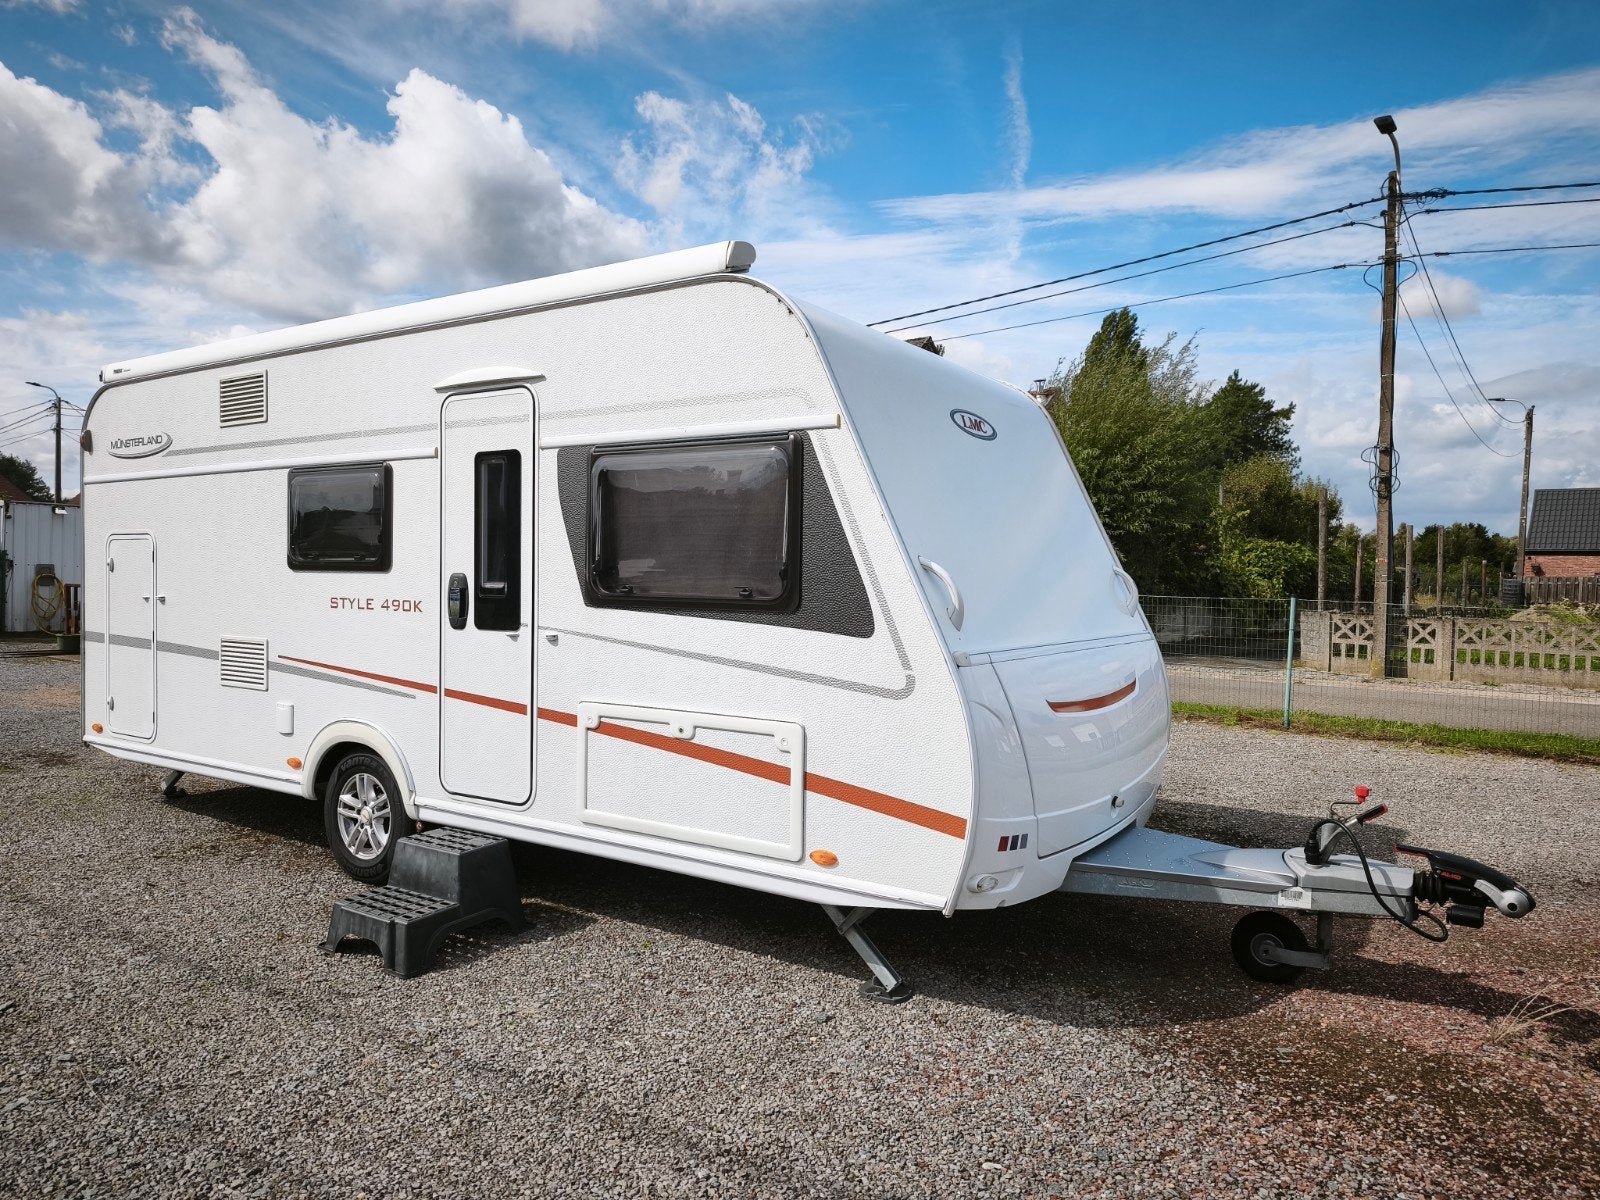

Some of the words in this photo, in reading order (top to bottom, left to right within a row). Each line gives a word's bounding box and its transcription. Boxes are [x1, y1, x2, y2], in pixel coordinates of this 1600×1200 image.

[959, 413, 988, 434] LMC
[330, 597, 375, 610] STYLE
[380, 598, 423, 613] 490K
